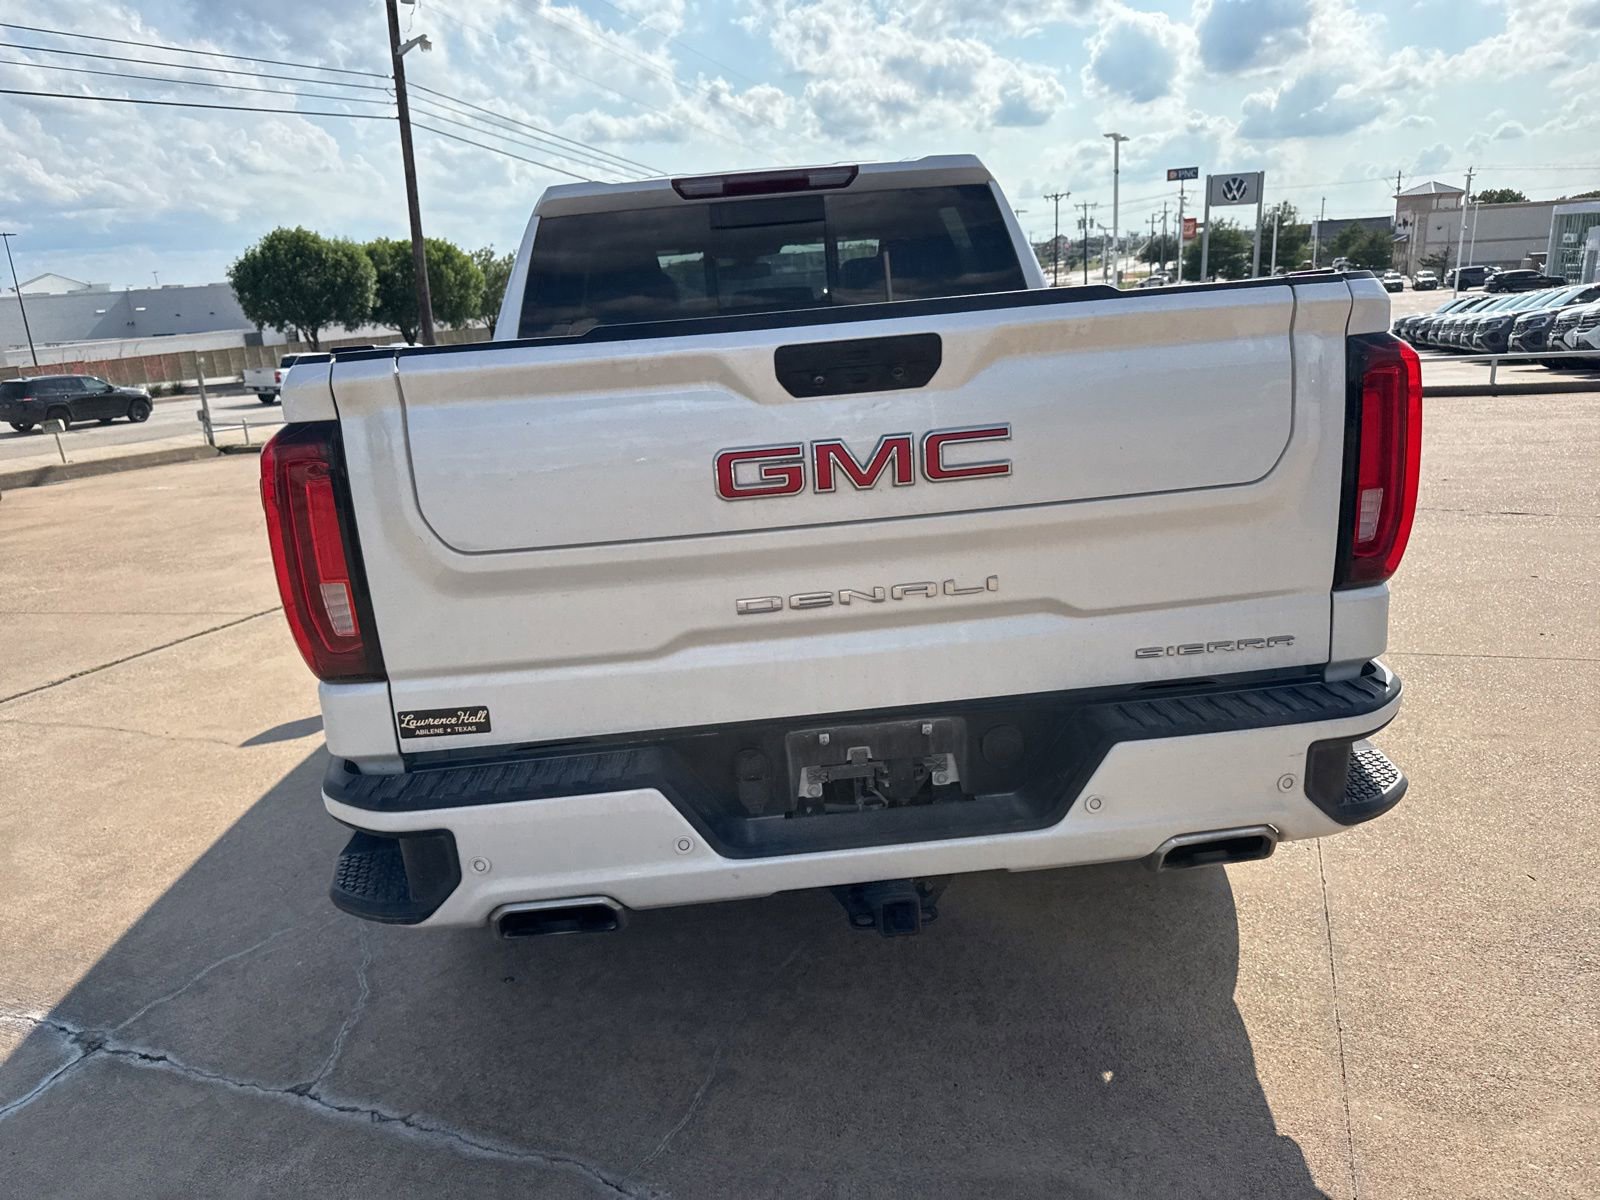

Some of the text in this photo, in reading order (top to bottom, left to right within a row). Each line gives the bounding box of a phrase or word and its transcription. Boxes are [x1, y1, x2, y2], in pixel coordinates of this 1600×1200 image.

[1178, 169, 1197, 177] PNC
[713, 422, 1012, 501] GMC
[736, 575, 998, 615] DENALI
[1135, 635, 1295, 659] SIERRA
[401, 710, 488, 729] Lawrence Hall
[415, 725, 477, 736] ABILENE TEXAS
